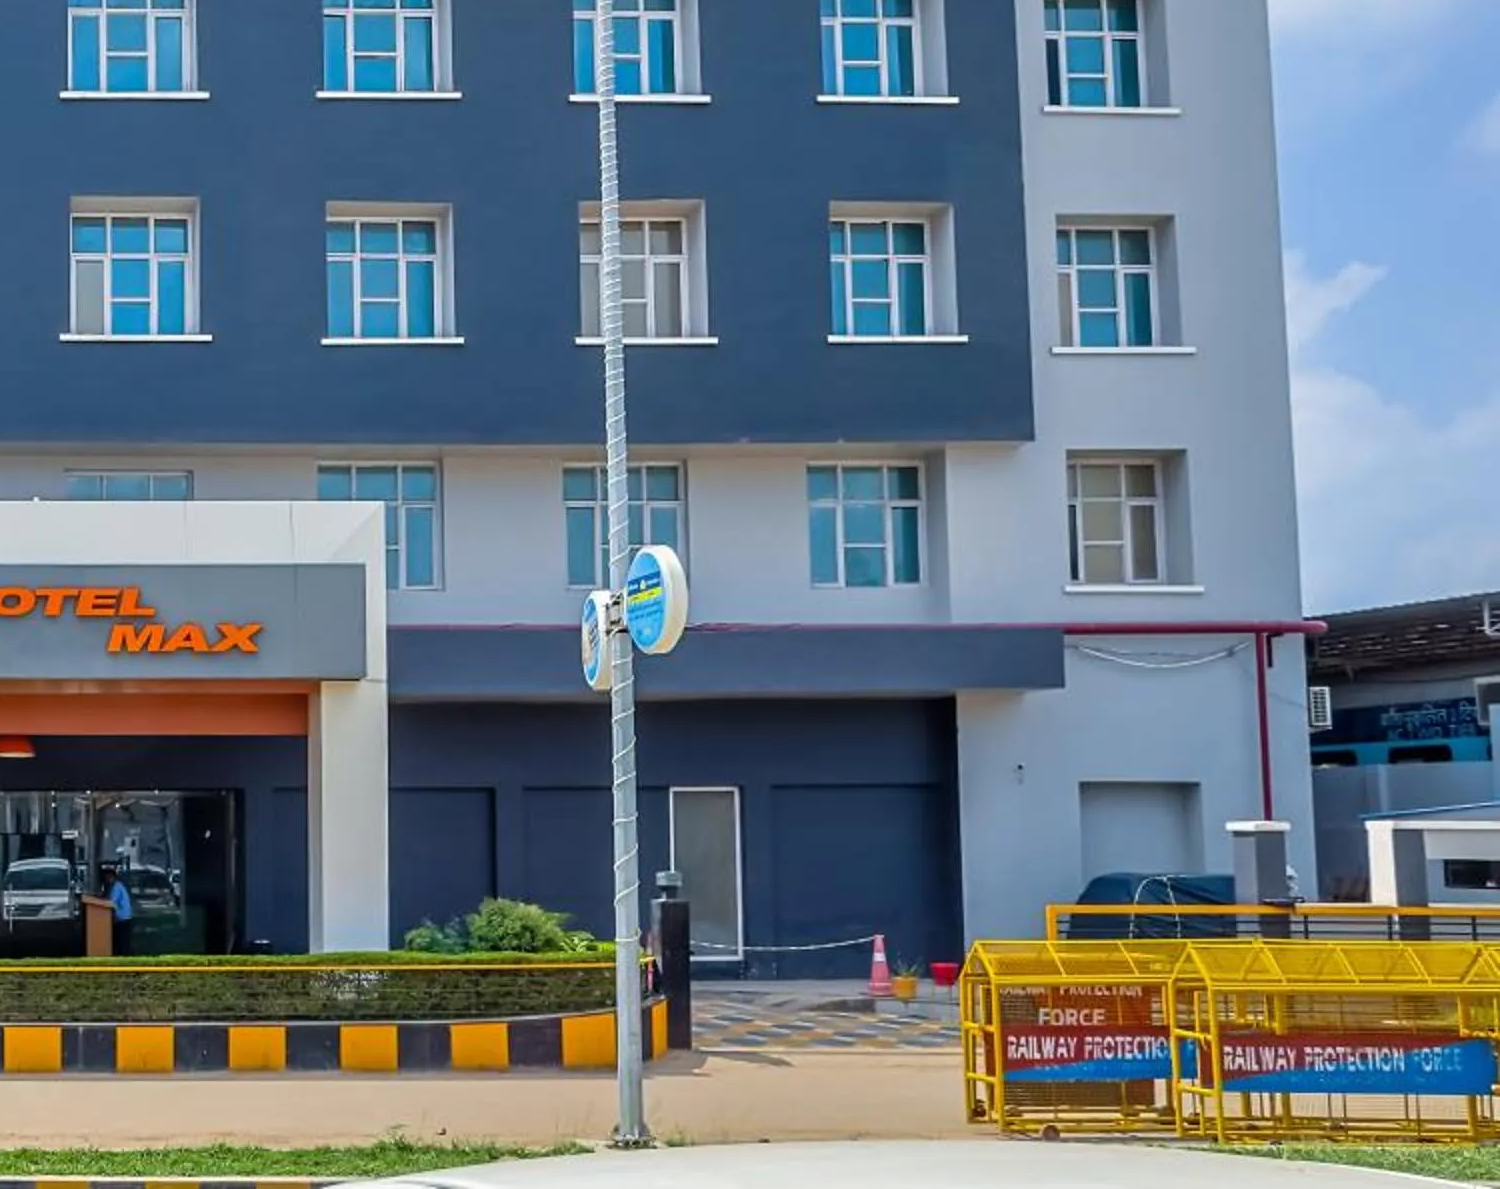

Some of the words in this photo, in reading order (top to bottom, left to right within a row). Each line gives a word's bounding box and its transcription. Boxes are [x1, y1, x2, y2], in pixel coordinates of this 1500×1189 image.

[108, 623, 262, 653] MAX
[1038, 1007, 1106, 1026] FORCE
[1007, 1036, 1077, 1060] RAILWAY
[1084, 1036, 1171, 1060] PROTECTIO
[1223, 1046, 1297, 1071] RAILWAY
[1304, 1047, 1404, 1073] PROTECTION
